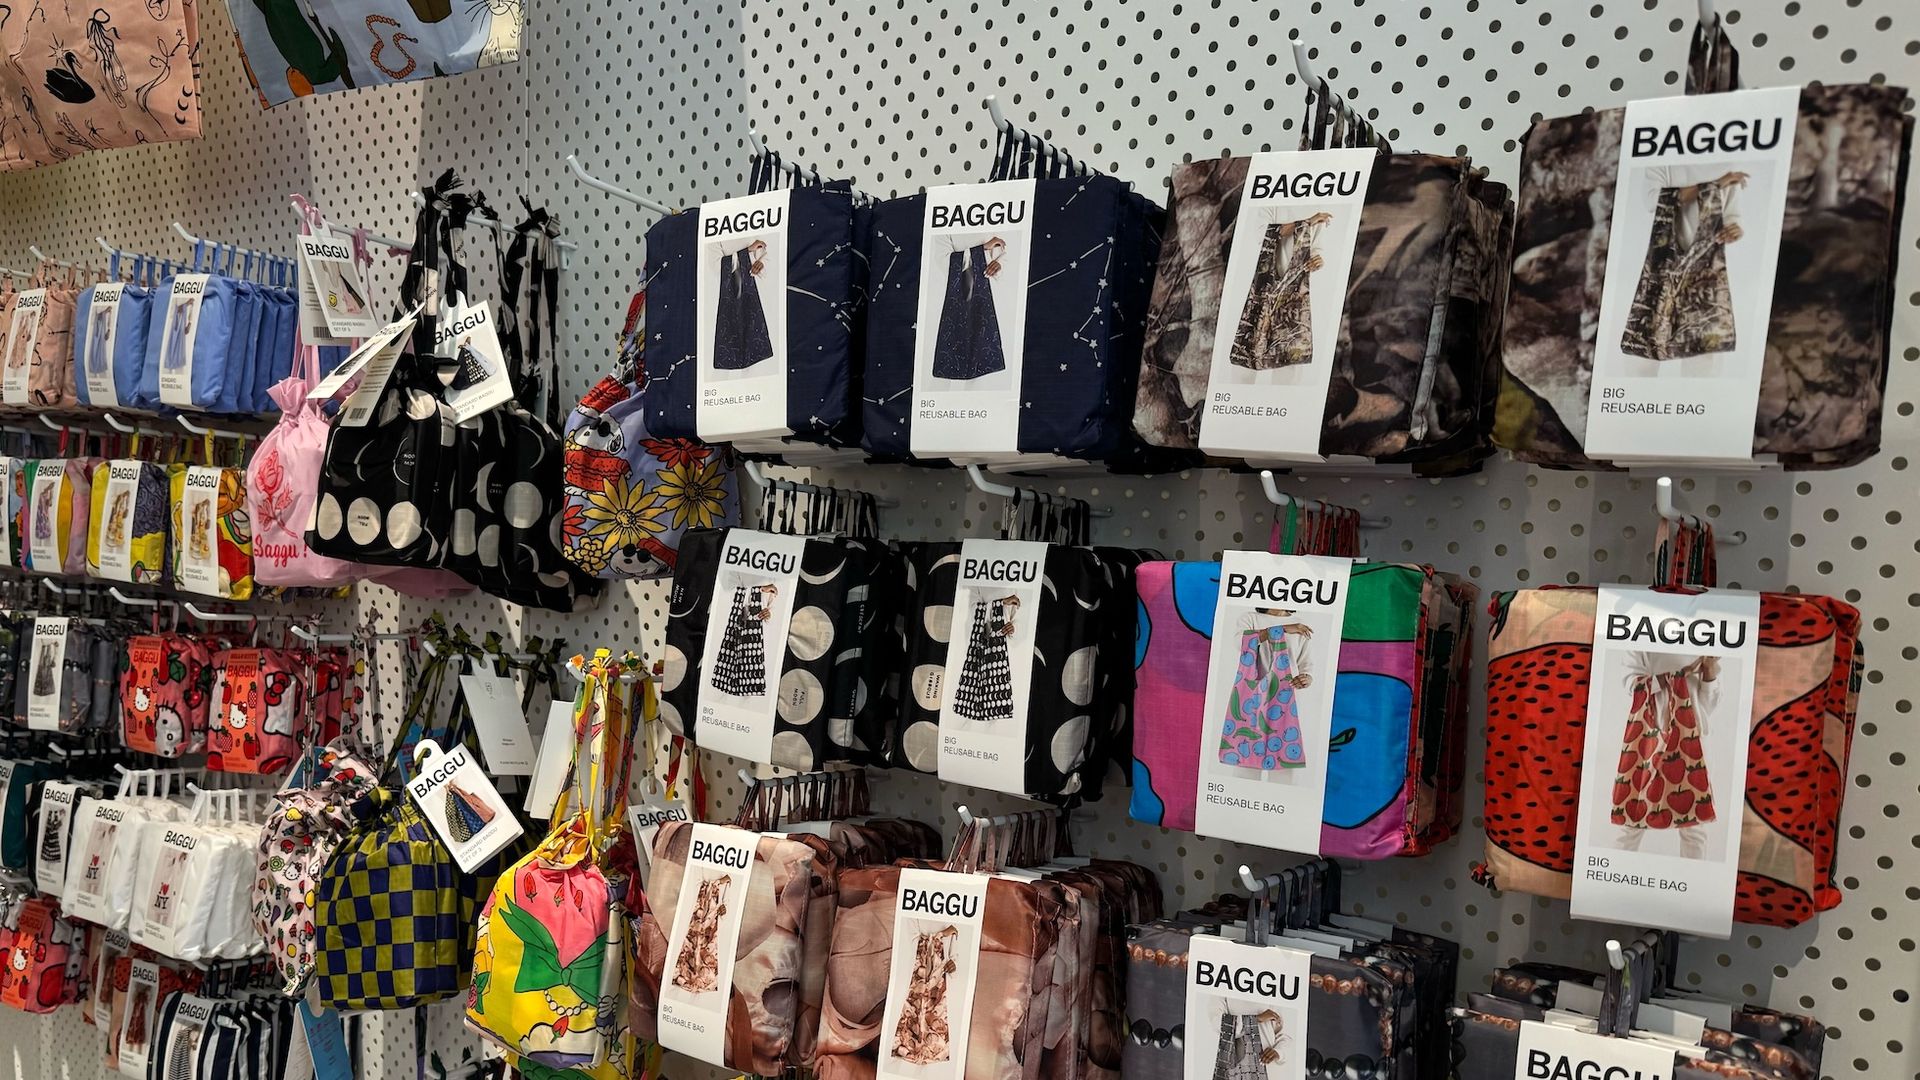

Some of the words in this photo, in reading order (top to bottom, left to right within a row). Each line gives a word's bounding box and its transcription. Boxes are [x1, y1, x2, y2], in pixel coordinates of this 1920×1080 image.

[1631, 118, 1782, 158] BAGGU
[1250, 170, 1361, 200] BAGGU
[704, 206, 782, 238] BAGGU
[931, 200, 1026, 228] BAGGU
[304, 242, 350, 259] BAGGU
[174, 281, 204, 294] BAGGU
[18, 296, 42, 308] BAGGU
[94, 290, 120, 302] BAGGU
[434, 310, 486, 346] BAGGU
[703, 396, 742, 406] REUSABLE
[744, 393, 761, 404] BAG
[704, 388, 717, 398] BIG
[1214, 392, 1232, 402] BIG
[1602, 388, 1626, 399] BIG
[920, 399, 936, 408] BIG
[1212, 405, 1264, 416] REUSABLE
[1265, 407, 1288, 417] BAG
[1600, 402, 1672, 415] REUSABLE
[1675, 404, 1706, 416] BAG
[919, 410, 966, 419] REUSABLE
[968, 410, 988, 418] BAG
[38, 466, 63, 476] BAGGU
[112, 467, 138, 480] BAGGU
[187, 474, 218, 488] BAGGU
[725, 546, 796, 574] BAGGU
[963, 558, 1038, 582] BAGGU
[1226, 573, 1338, 606] BAGGU
[36, 624, 65, 635] BAGGU
[1606, 613, 1747, 649] BAGGU
[133, 651, 159, 664] BAGGU
[227, 664, 257, 678] BAGGU
[702, 706, 714, 716] BIG
[702, 716, 736, 731] REUSABLE
[736, 724, 750, 734] BAG
[944, 736, 956, 745] BIG
[944, 746, 982, 760] REUSABLE
[983, 752, 999, 762] BAG
[414, 752, 466, 798] BAGGU
[1207, 782, 1225, 793] BIG
[44, 788, 72, 804] BAGGU
[1206, 794, 1260, 811] REUSABLE
[1262, 802, 1285, 814] BAG
[96, 806, 124, 822] BAGGU
[637, 808, 688, 827] BAGGU
[164, 830, 198, 850] BAGGU
[692, 840, 750, 869] BAGGU
[1588, 855, 1610, 868] BIG
[1586, 870, 1656, 888] REUSABLE
[1659, 879, 1688, 892] BAG
[902, 889, 978, 918] BAGGU
[105, 931, 129, 949] BAGGU
[132, 966, 158, 982] BAGGU
[1196, 960, 1300, 1000] BAGGU
[178, 1002, 209, 1020] BAGGU
[663, 1004, 673, 1014] BIG
[662, 1014, 692, 1030] REUSABLE
[692, 1023, 705, 1034] BAG
[1527, 1049, 1660, 1080] BAG
